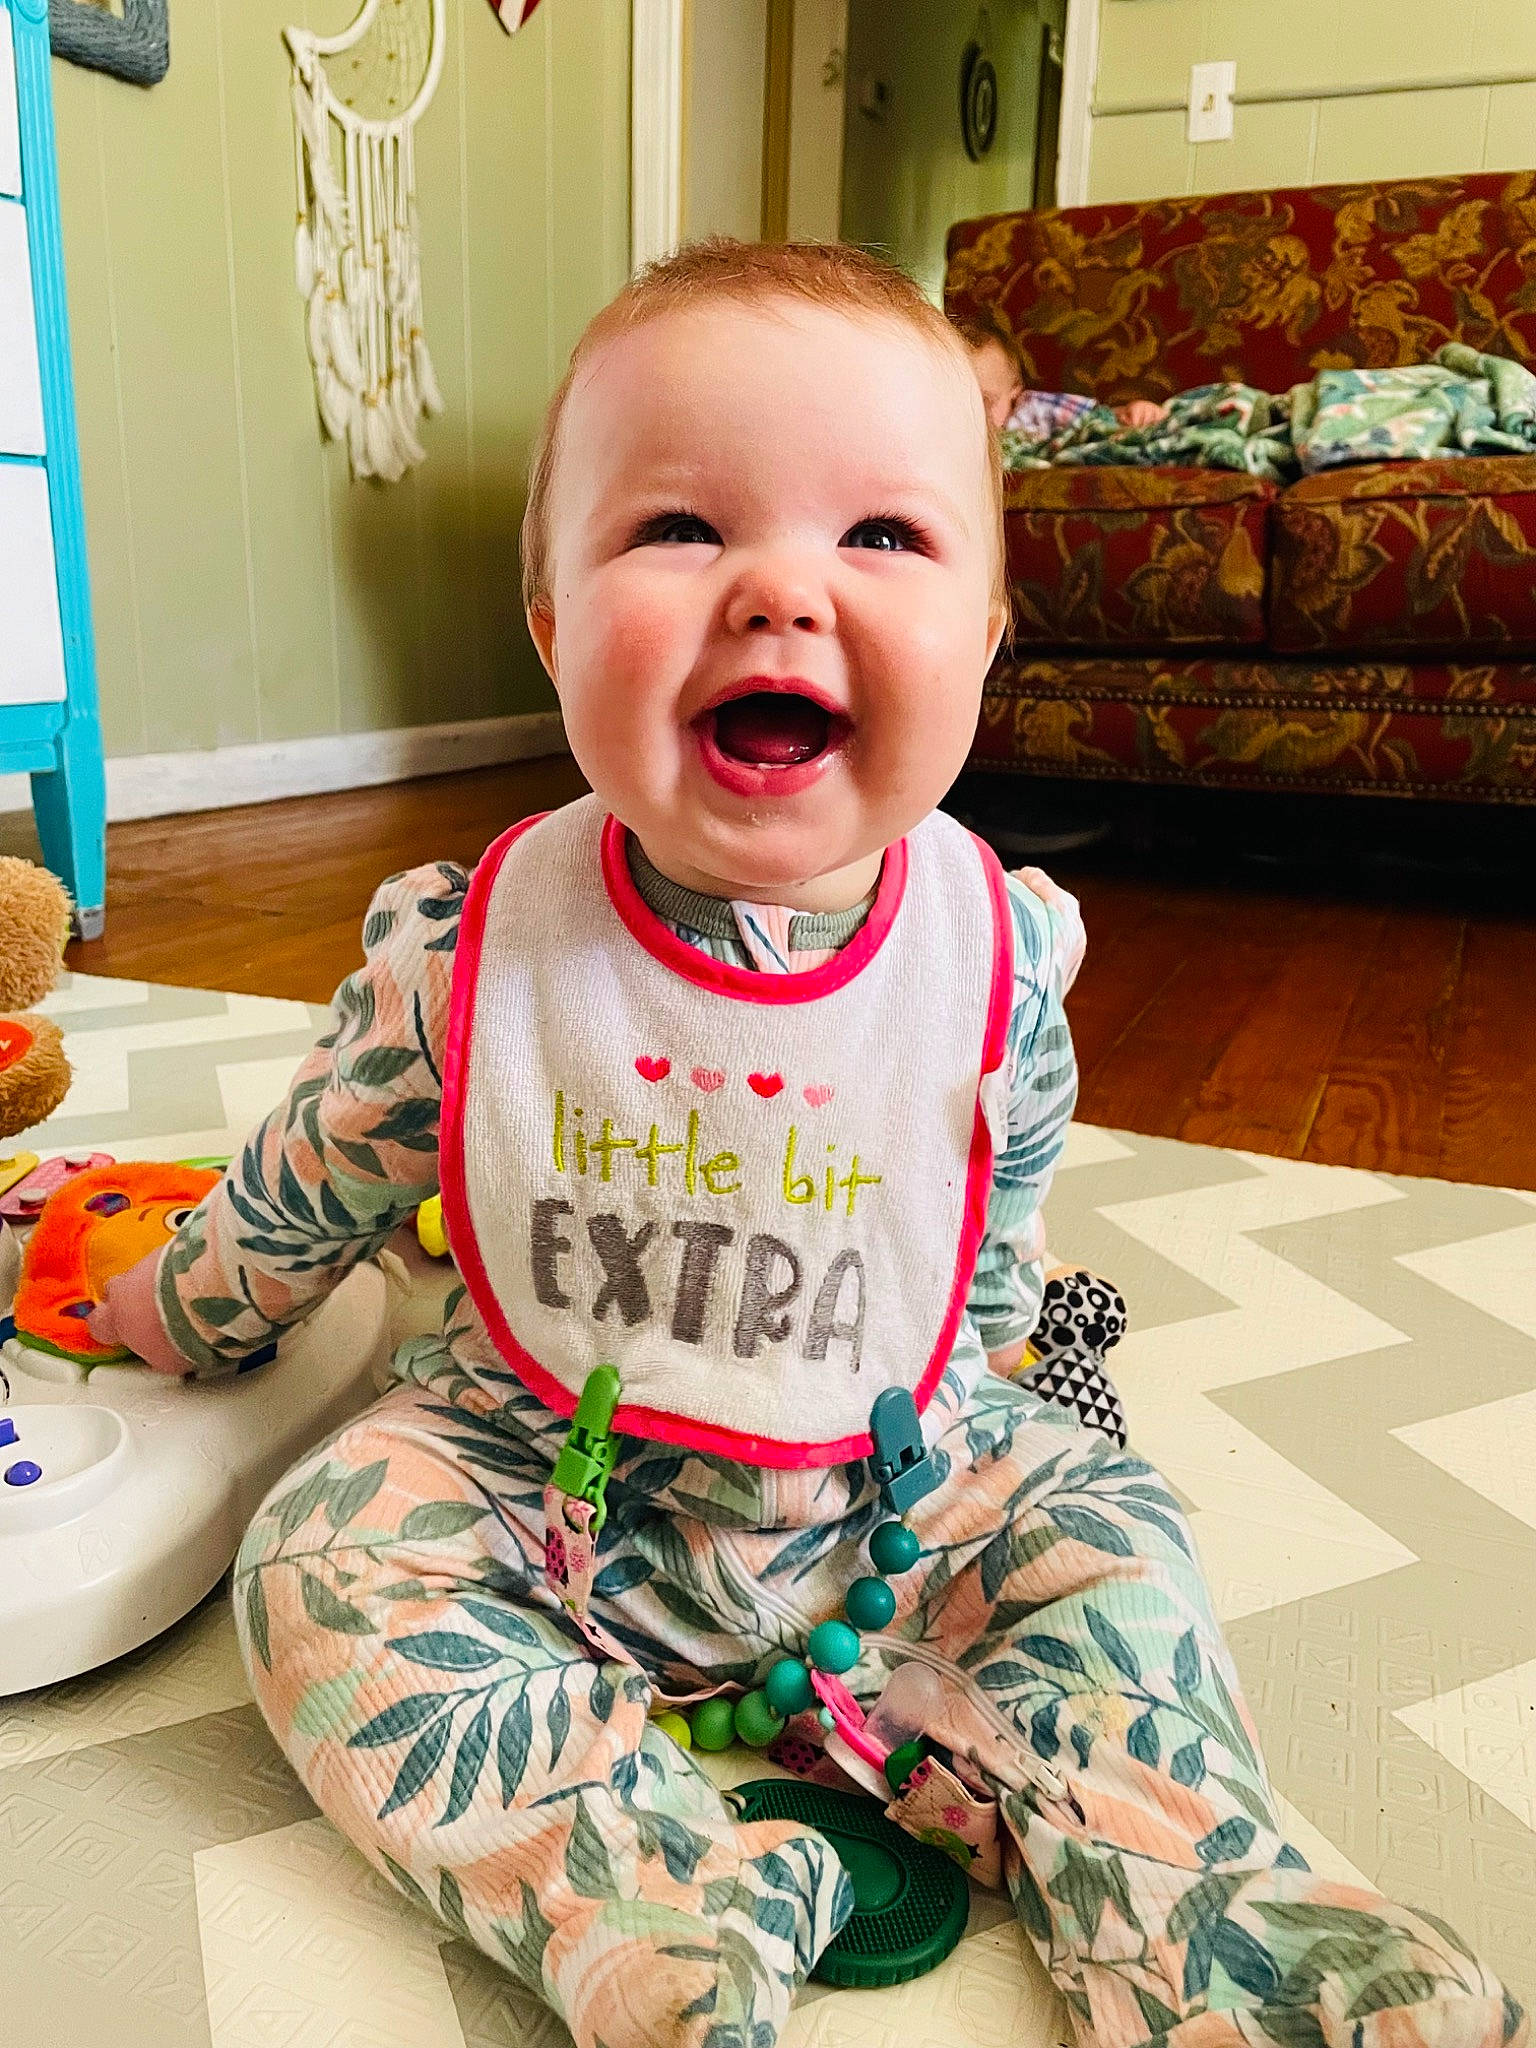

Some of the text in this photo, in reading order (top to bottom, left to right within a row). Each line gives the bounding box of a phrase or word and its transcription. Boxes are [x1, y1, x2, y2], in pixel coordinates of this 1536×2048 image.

[552, 1090, 882, 1217] little bit
[529, 1198, 868, 1374] EXTRA
